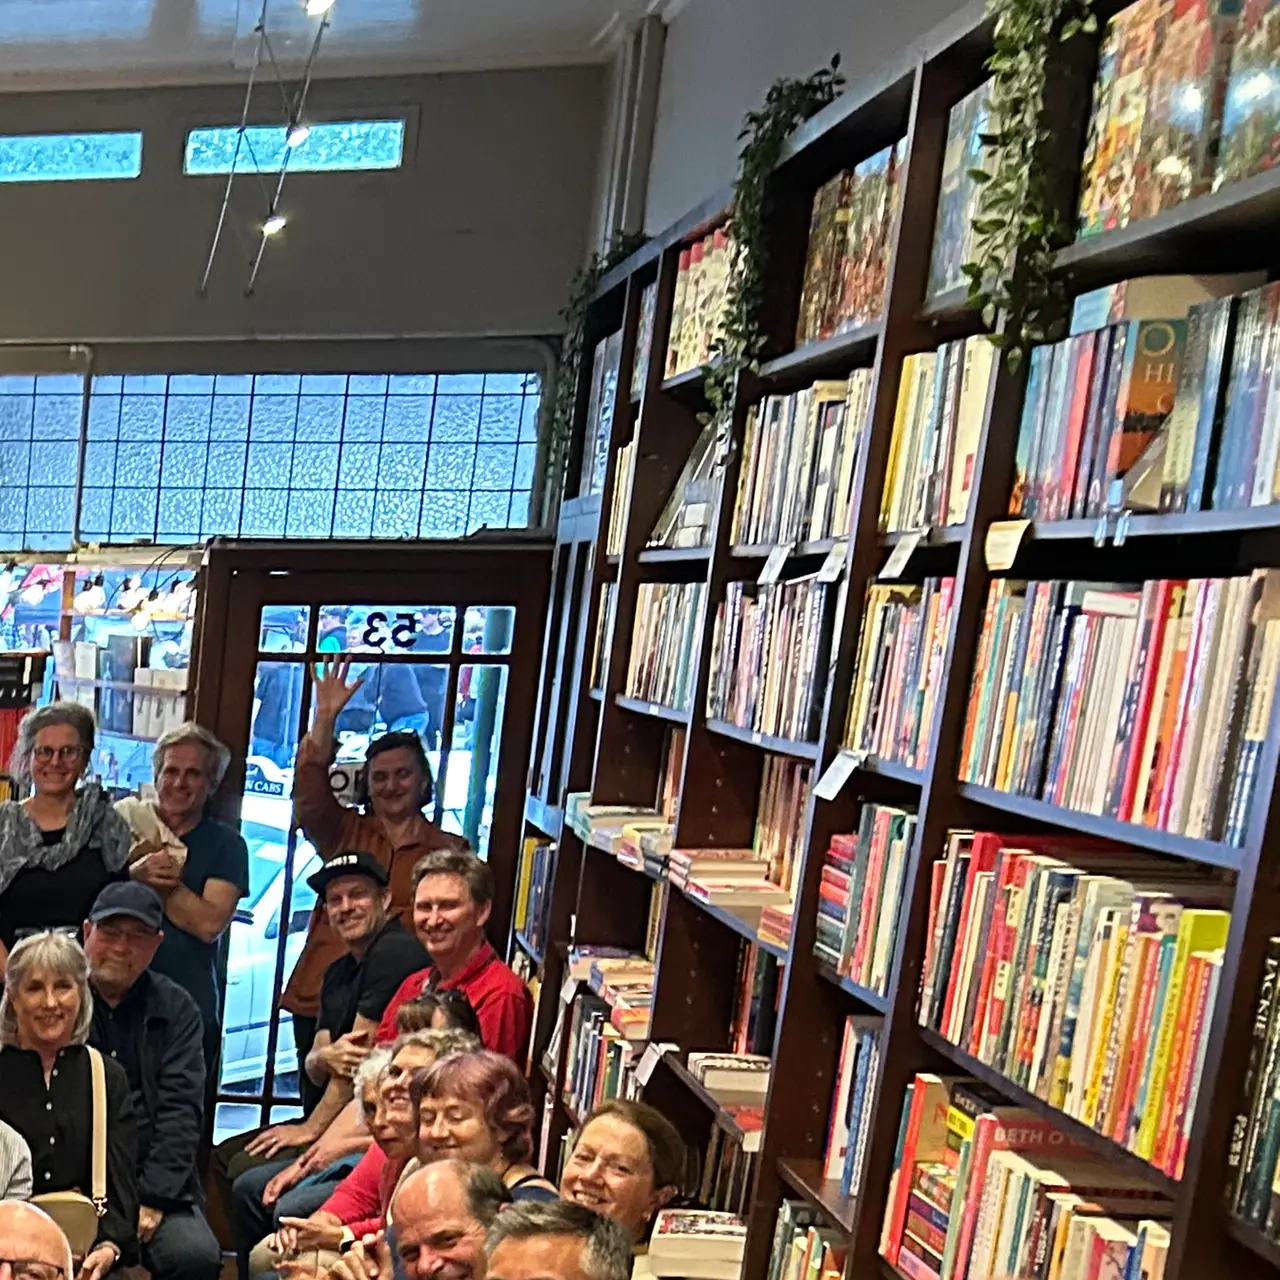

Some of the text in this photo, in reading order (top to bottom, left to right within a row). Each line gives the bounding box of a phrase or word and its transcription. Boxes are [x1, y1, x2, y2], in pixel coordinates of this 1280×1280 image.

[255, 781, 283, 793] CABS
[1253, 958, 1278, 1037] JACKIE
[994, 1127, 1043, 1143] BETH
